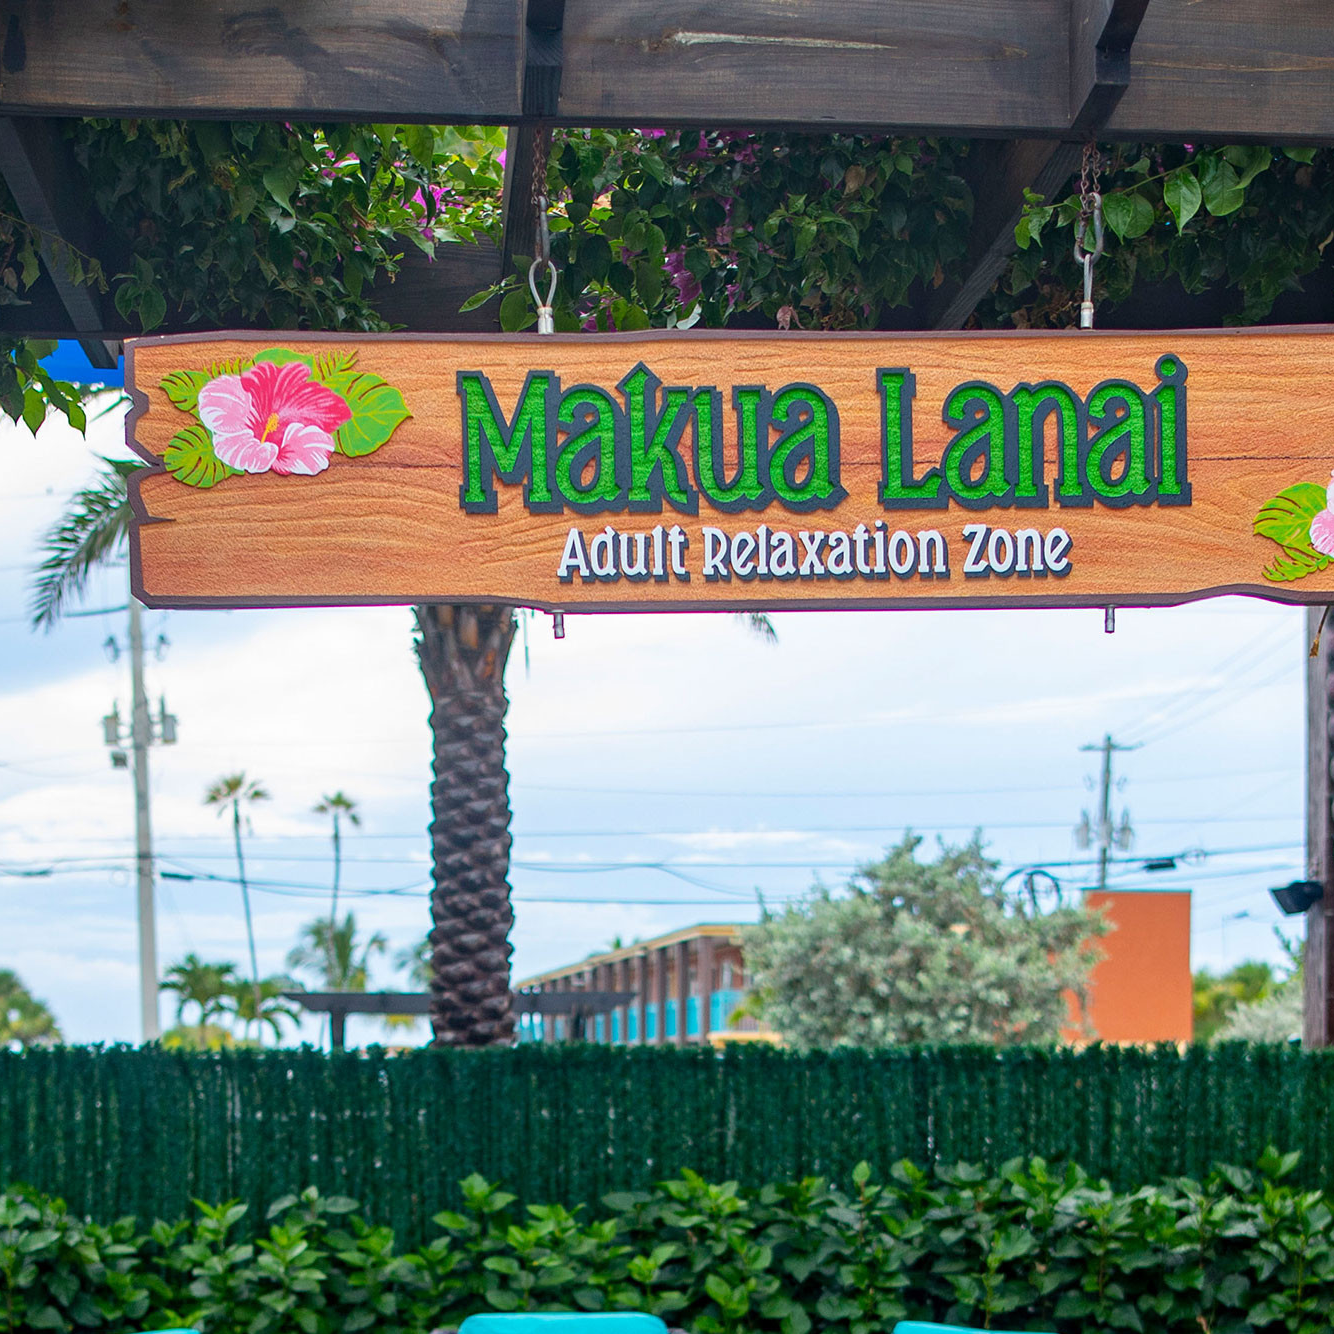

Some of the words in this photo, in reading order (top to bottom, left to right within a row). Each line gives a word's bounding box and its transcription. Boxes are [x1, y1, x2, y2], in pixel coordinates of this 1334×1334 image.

[458, 363, 847, 513] Makua
[878, 356, 1189, 507] Lanai
[557, 524, 689, 581] Adult
[702, 519, 948, 579] Relaxation
[962, 523, 1072, 578] Zone
